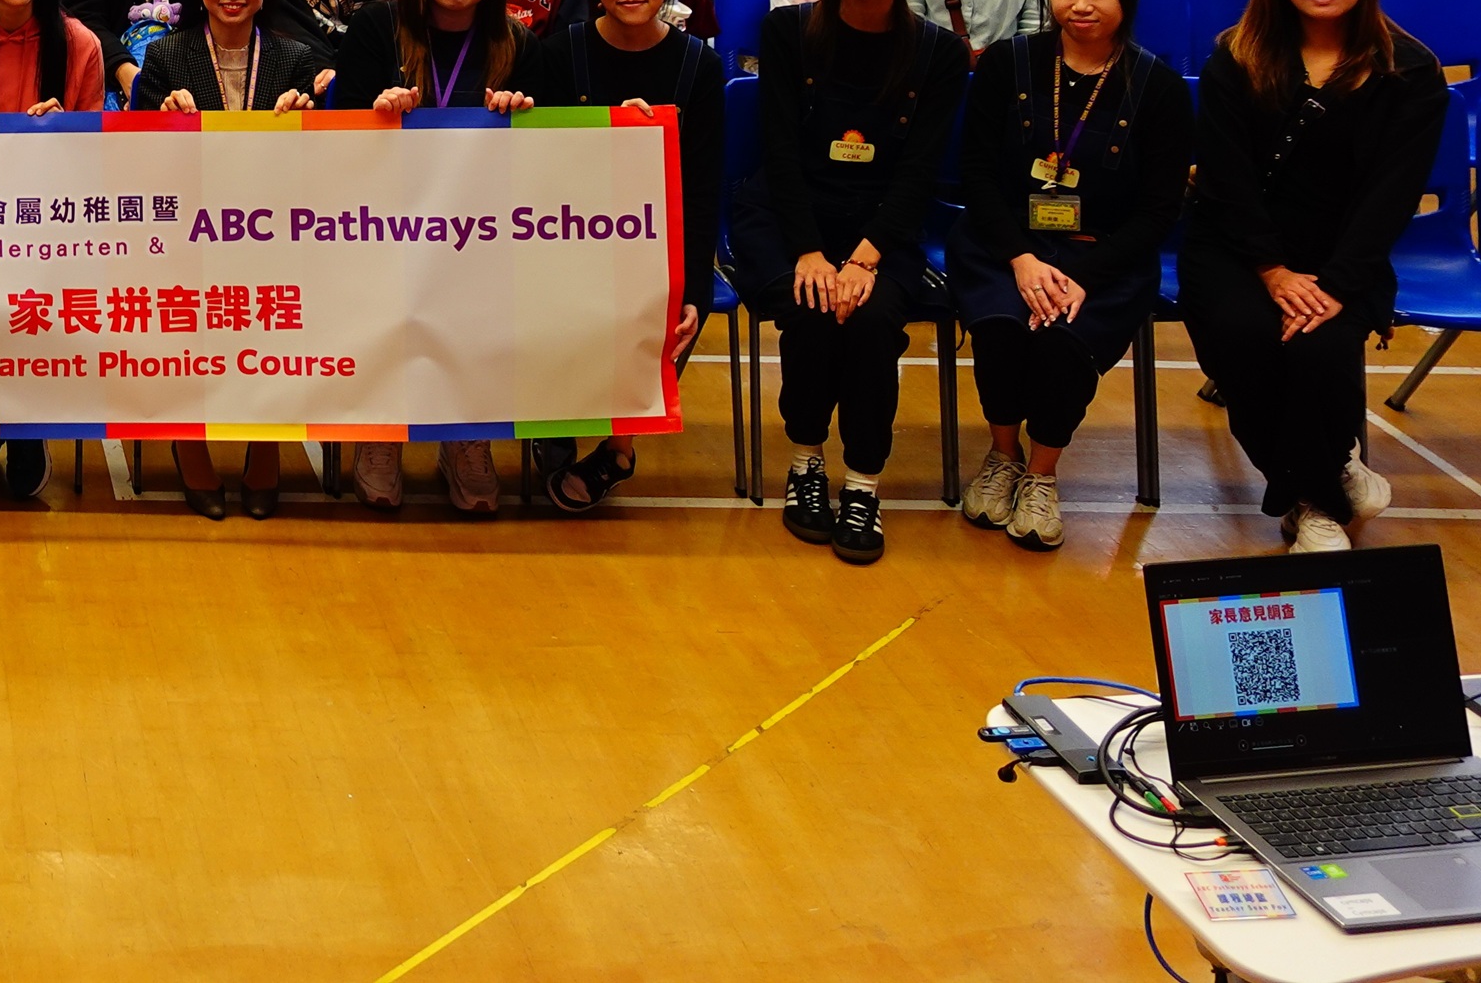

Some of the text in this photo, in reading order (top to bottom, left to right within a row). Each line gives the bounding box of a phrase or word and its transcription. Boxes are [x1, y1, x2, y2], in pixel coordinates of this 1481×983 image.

[188, 203, 657, 252] ABC Pathways School
[149, 236, 165, 255] &
[6, 284, 304, 336] 家長拼音課程
[98, 349, 226, 378] Phonics
[236, 349, 356, 378] Course
[1208, 603, 1296, 625] 家長意見調查
